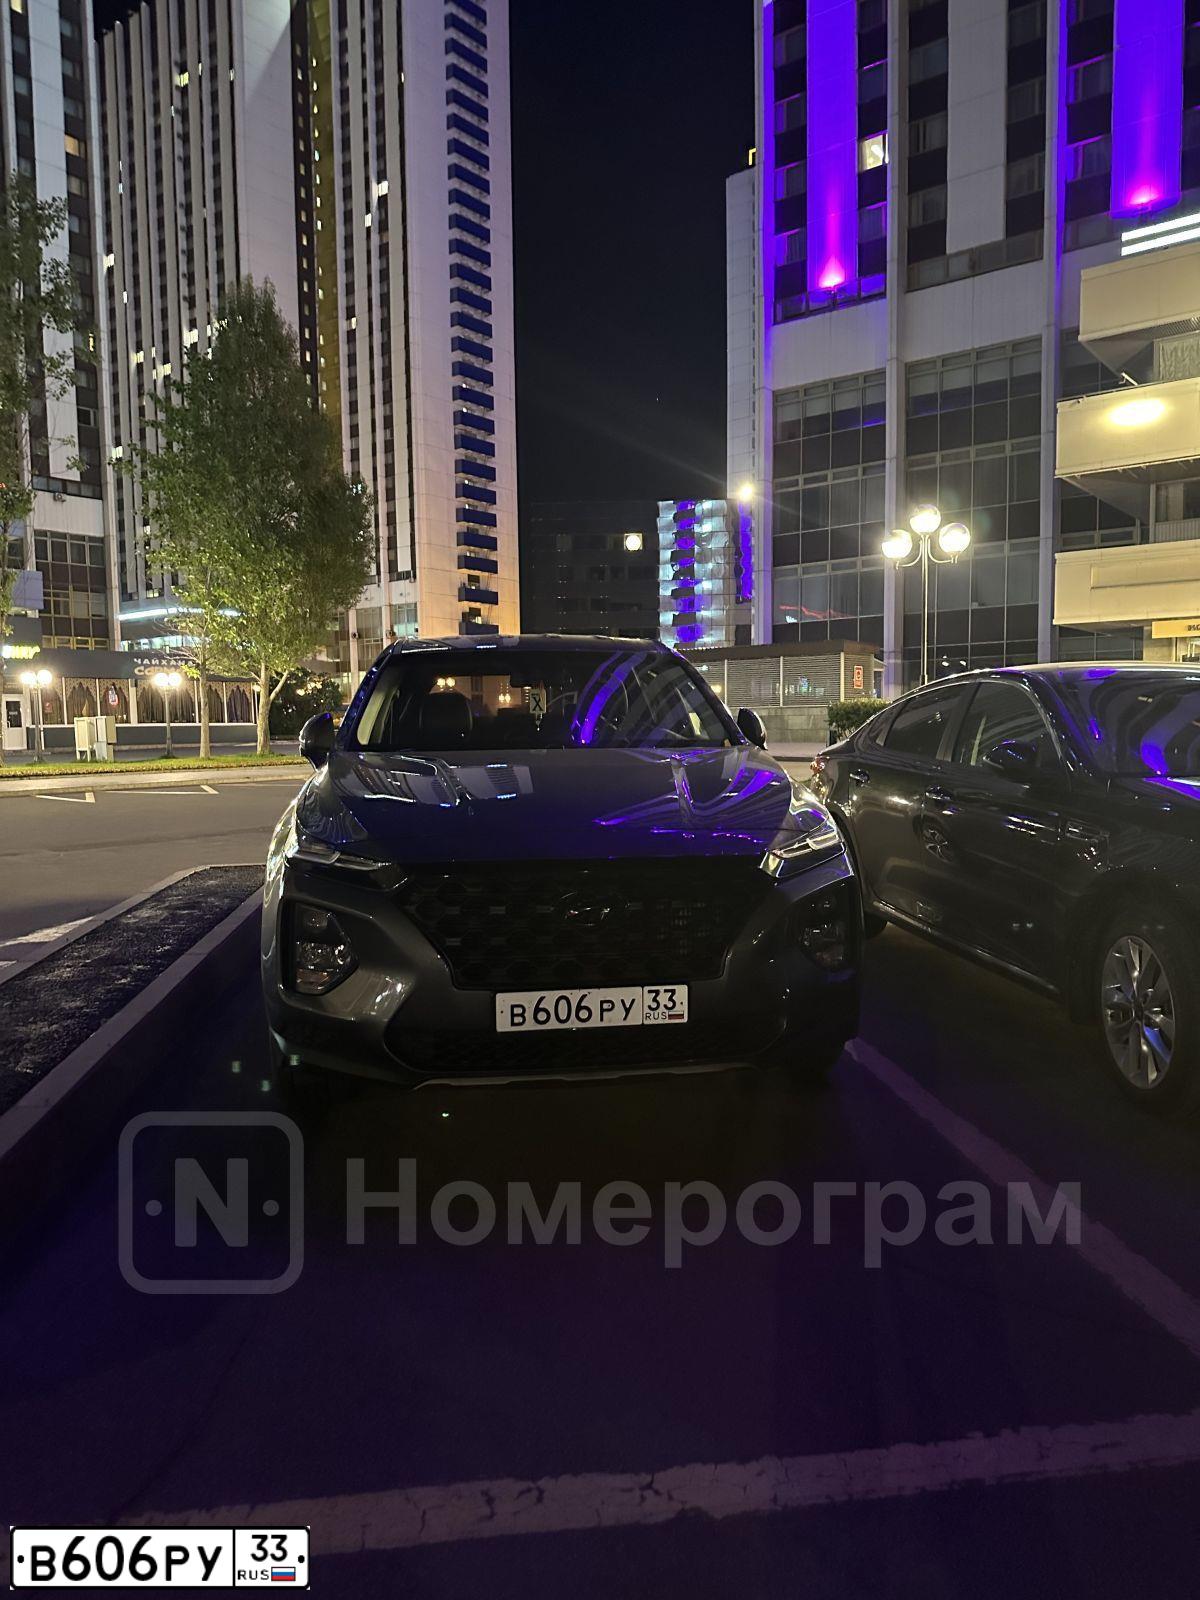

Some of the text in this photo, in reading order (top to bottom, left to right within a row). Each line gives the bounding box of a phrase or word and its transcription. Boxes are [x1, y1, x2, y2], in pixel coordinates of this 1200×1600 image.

[510, 988, 677, 1027] В606РУ 33
[644, 1011, 668, 1021] RUS
